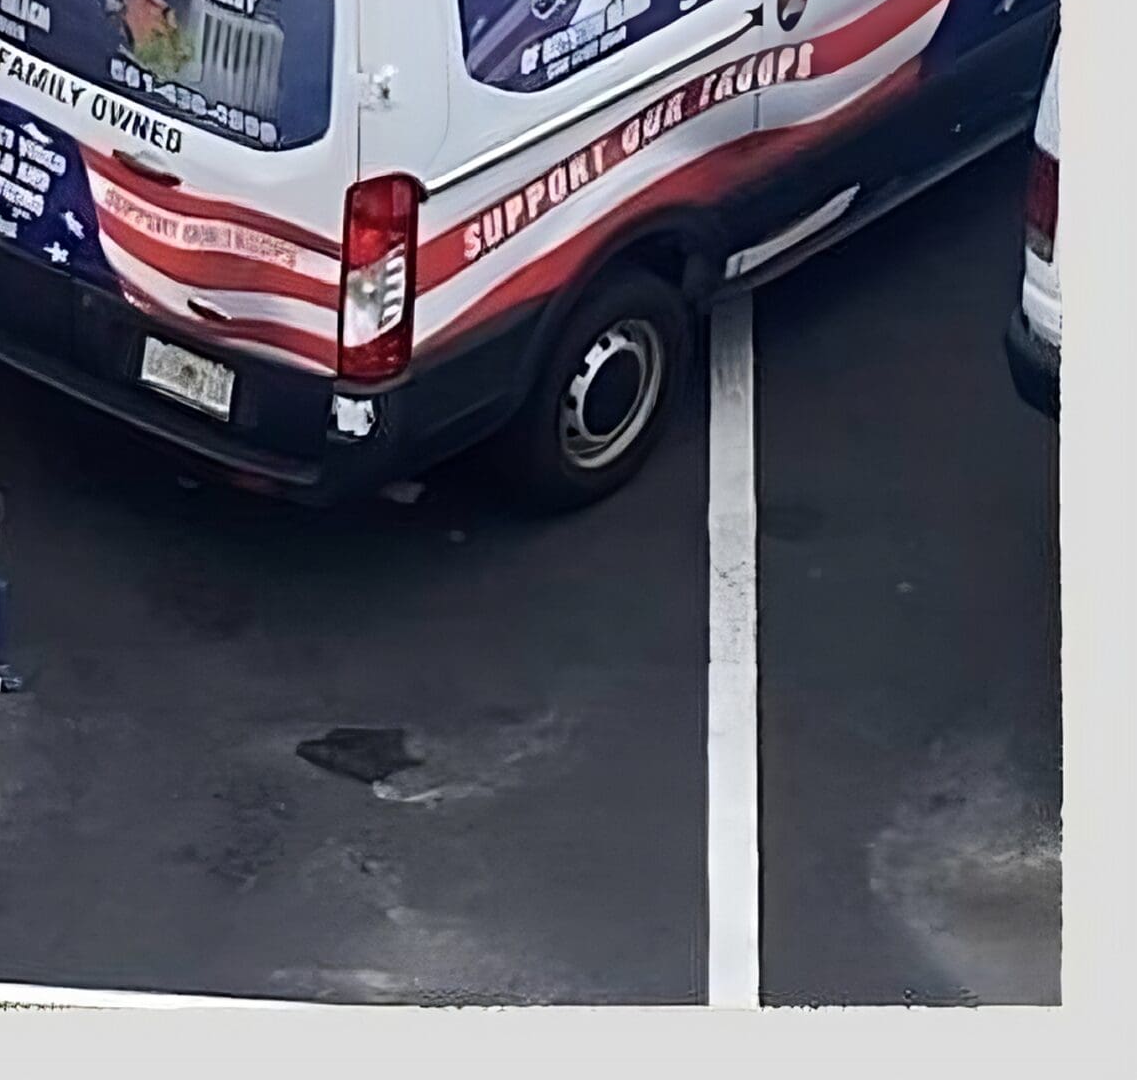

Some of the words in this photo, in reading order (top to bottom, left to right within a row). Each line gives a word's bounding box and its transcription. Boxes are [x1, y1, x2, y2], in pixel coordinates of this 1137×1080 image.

[91, 92, 183, 155] OWNED
[463, 138, 609, 260] SUPPORT
[620, 90, 683, 156] OUR
[699, 41, 815, 108] TROOPS
